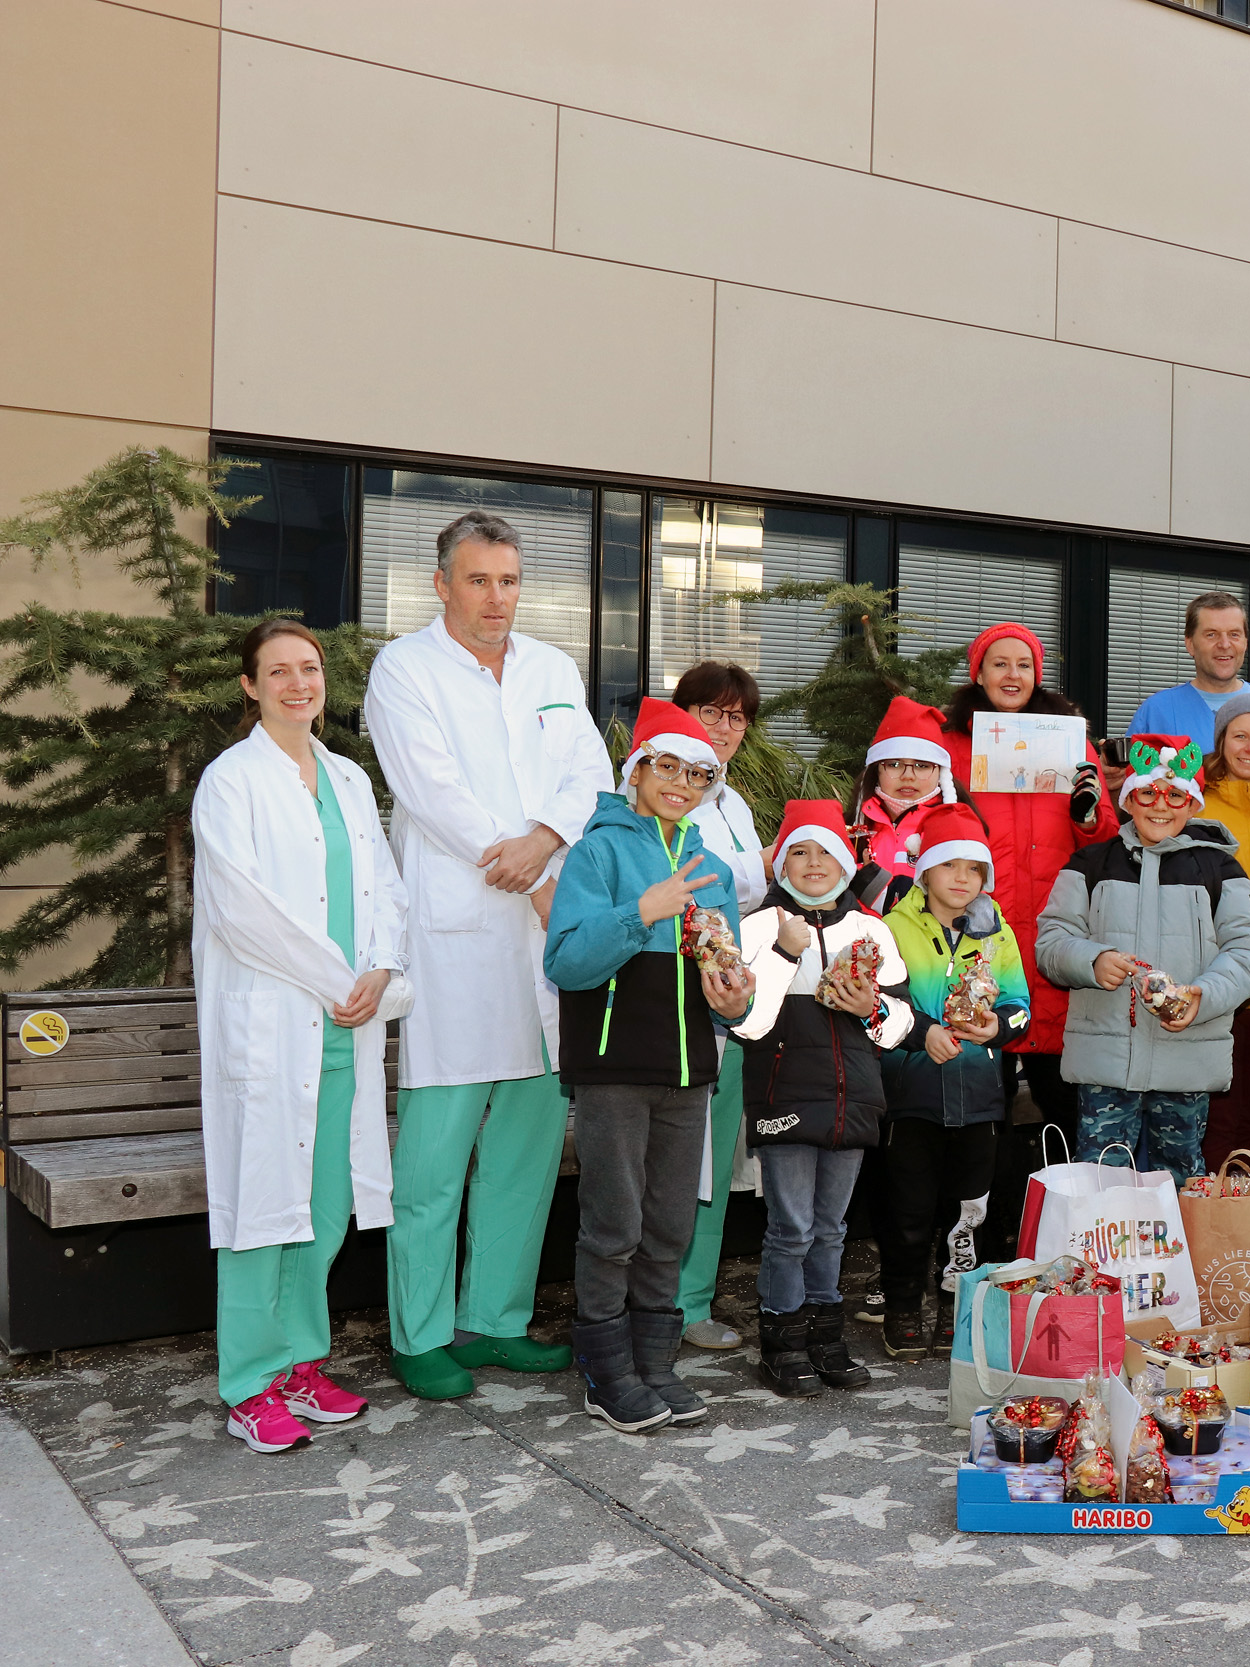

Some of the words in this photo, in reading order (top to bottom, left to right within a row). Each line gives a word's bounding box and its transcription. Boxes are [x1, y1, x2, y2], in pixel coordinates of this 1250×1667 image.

[1083, 1217, 1170, 1264] BÜCHER
[1200, 1258, 1220, 1282] AUS
[1072, 1508, 1152, 1529] HARIBO
